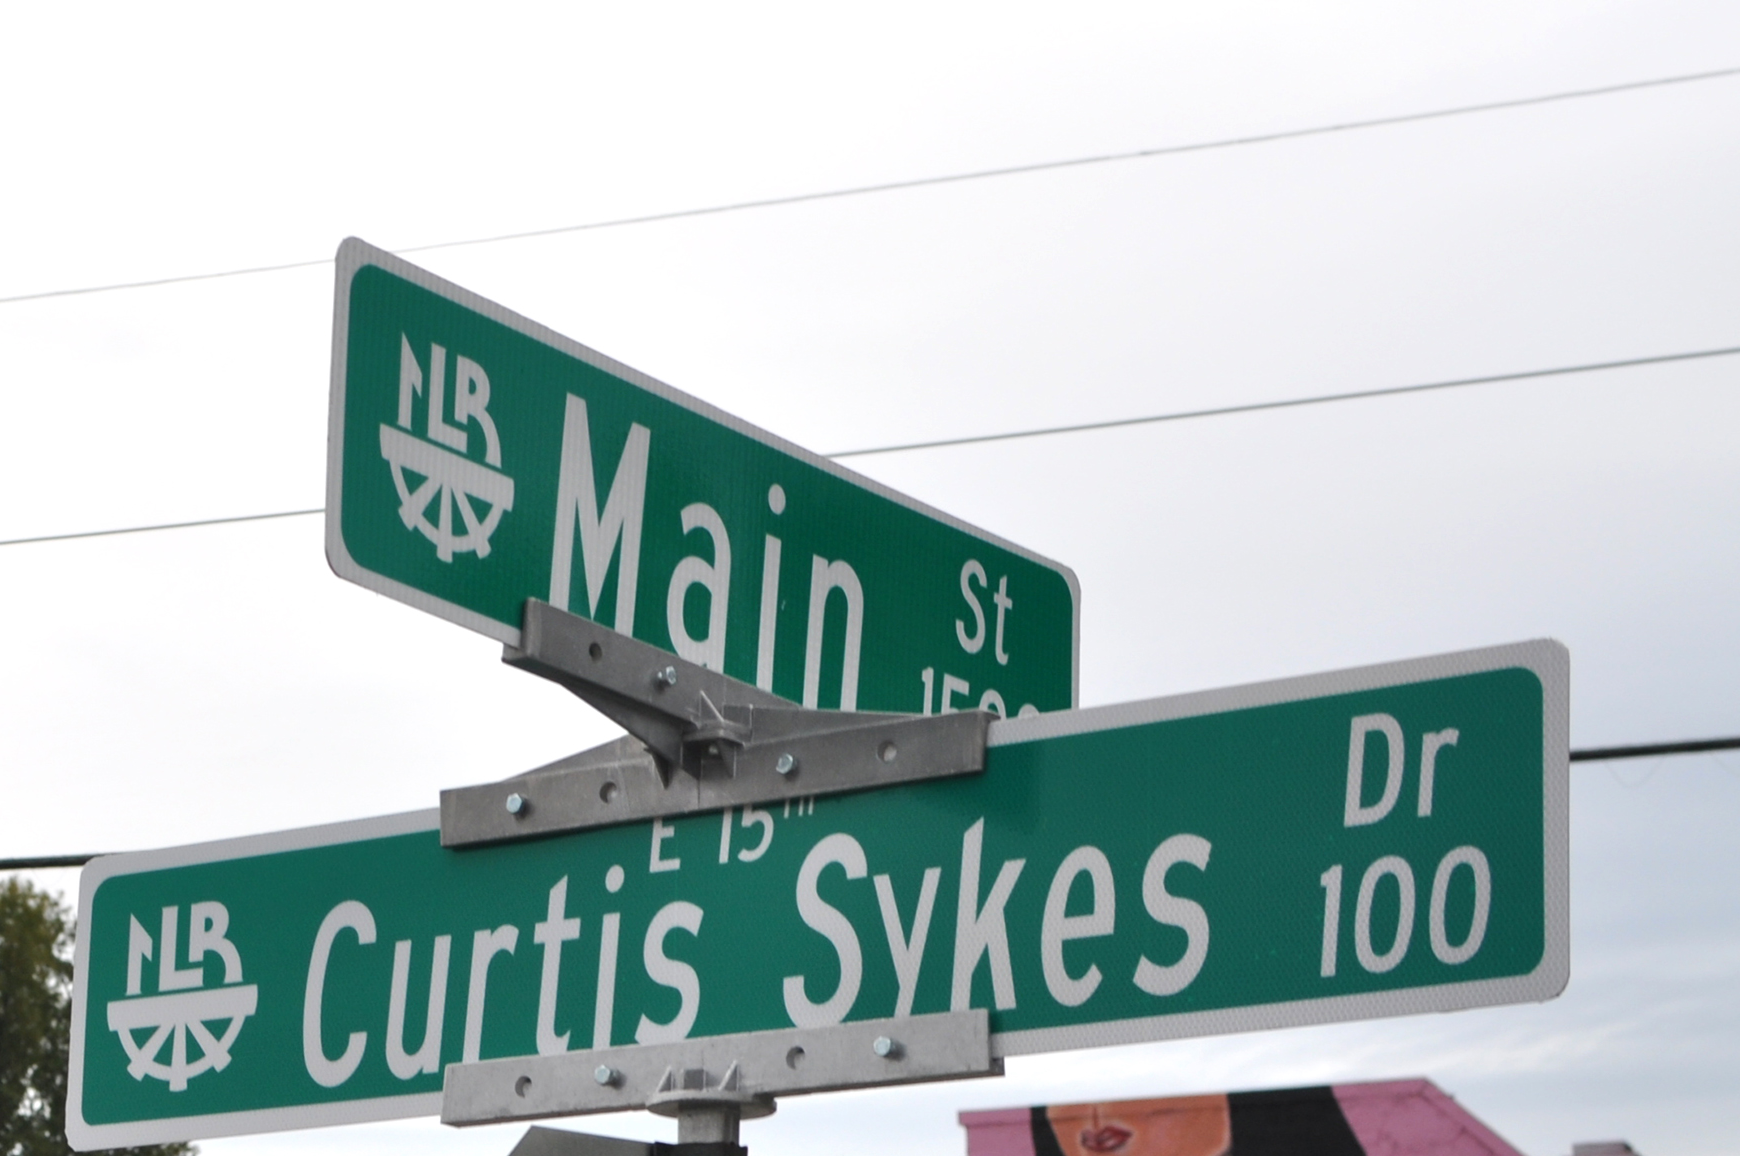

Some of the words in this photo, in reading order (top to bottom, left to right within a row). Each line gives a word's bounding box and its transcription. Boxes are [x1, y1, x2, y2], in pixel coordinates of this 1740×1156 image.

[549, 392, 864, 712] Main
[955, 558, 1013, 666] St
[1343, 712, 1459, 828] Dr
[649, 815, 681, 873] E
[302, 864, 705, 1088] Curtis
[783, 816, 1212, 1029] Sykes
[1320, 845, 1492, 978] 100
